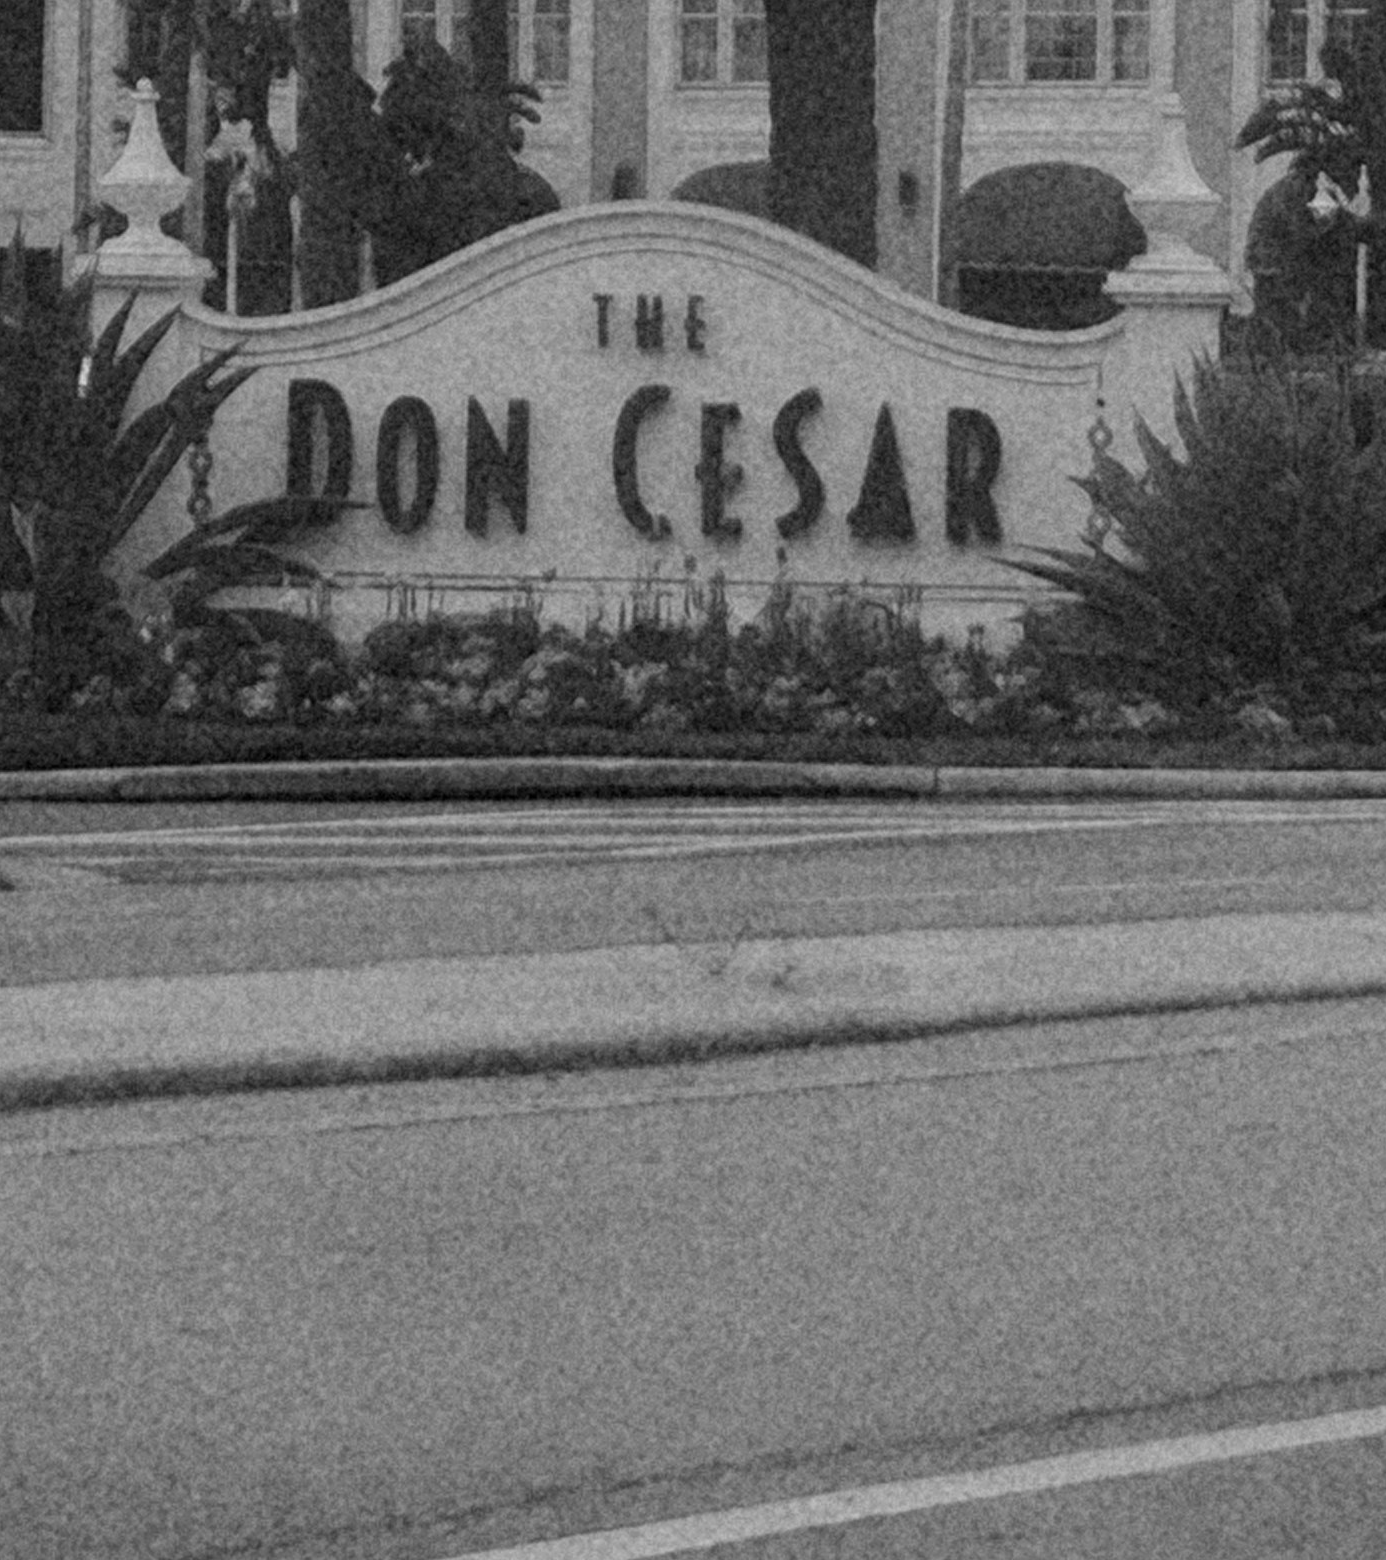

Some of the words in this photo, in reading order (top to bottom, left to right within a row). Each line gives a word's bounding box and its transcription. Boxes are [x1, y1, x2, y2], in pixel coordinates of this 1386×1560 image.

[592, 294, 706, 351] THE
[285, 378, 531, 538] DON
[613, 382, 1003, 548] CESAR
